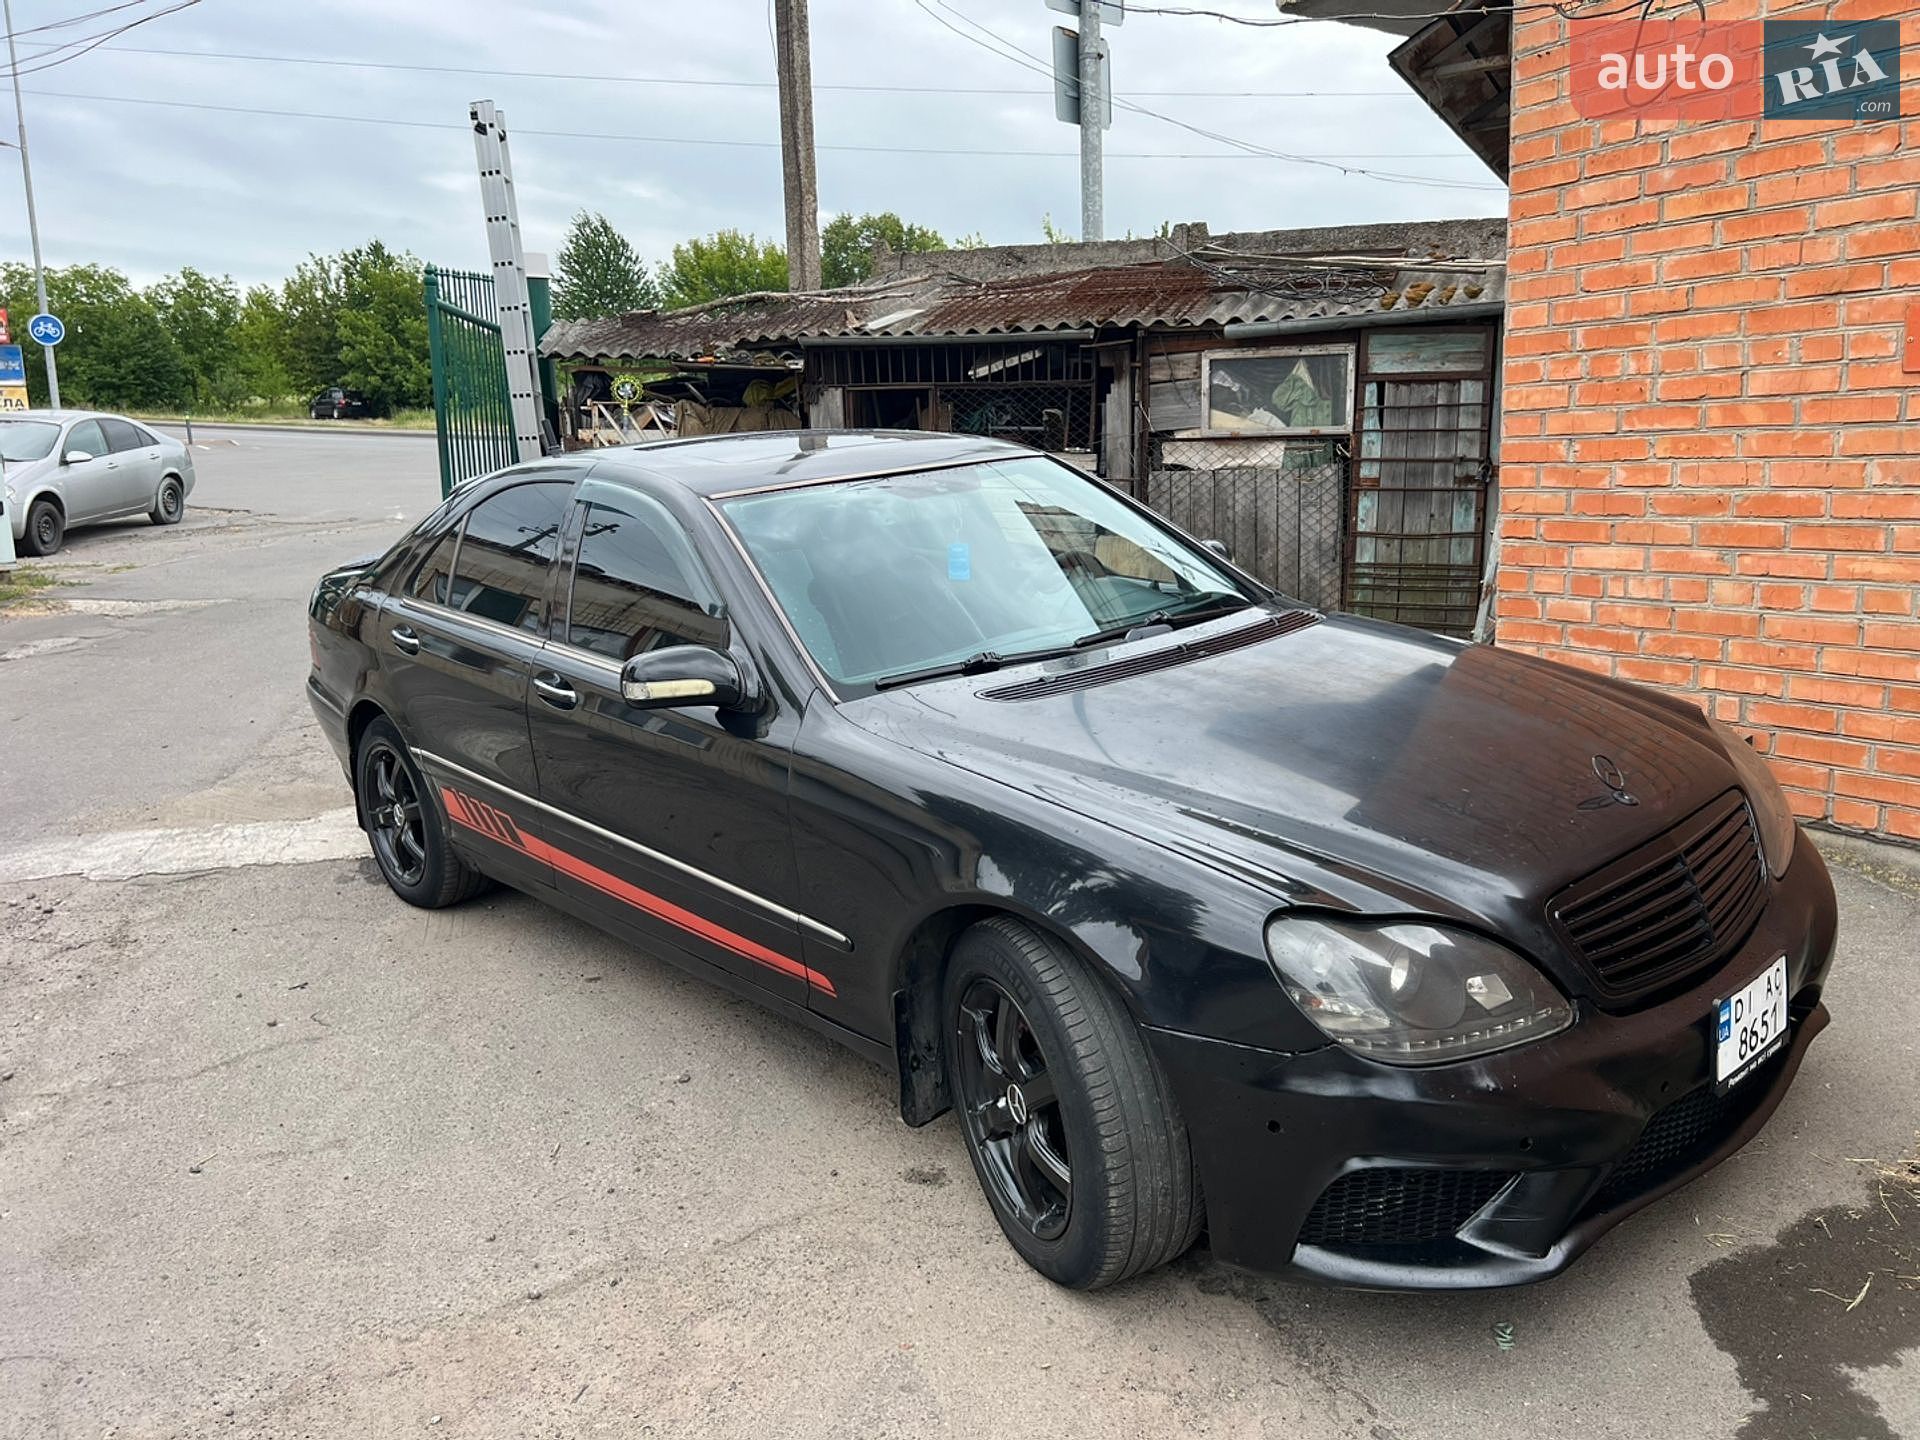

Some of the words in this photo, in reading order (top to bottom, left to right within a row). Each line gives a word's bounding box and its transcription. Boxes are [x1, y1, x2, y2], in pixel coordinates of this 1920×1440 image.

[1735, 991, 1752, 1024] DI
[1766, 967, 1781, 1000] AC
[1738, 1002, 1778, 1060] 8651
